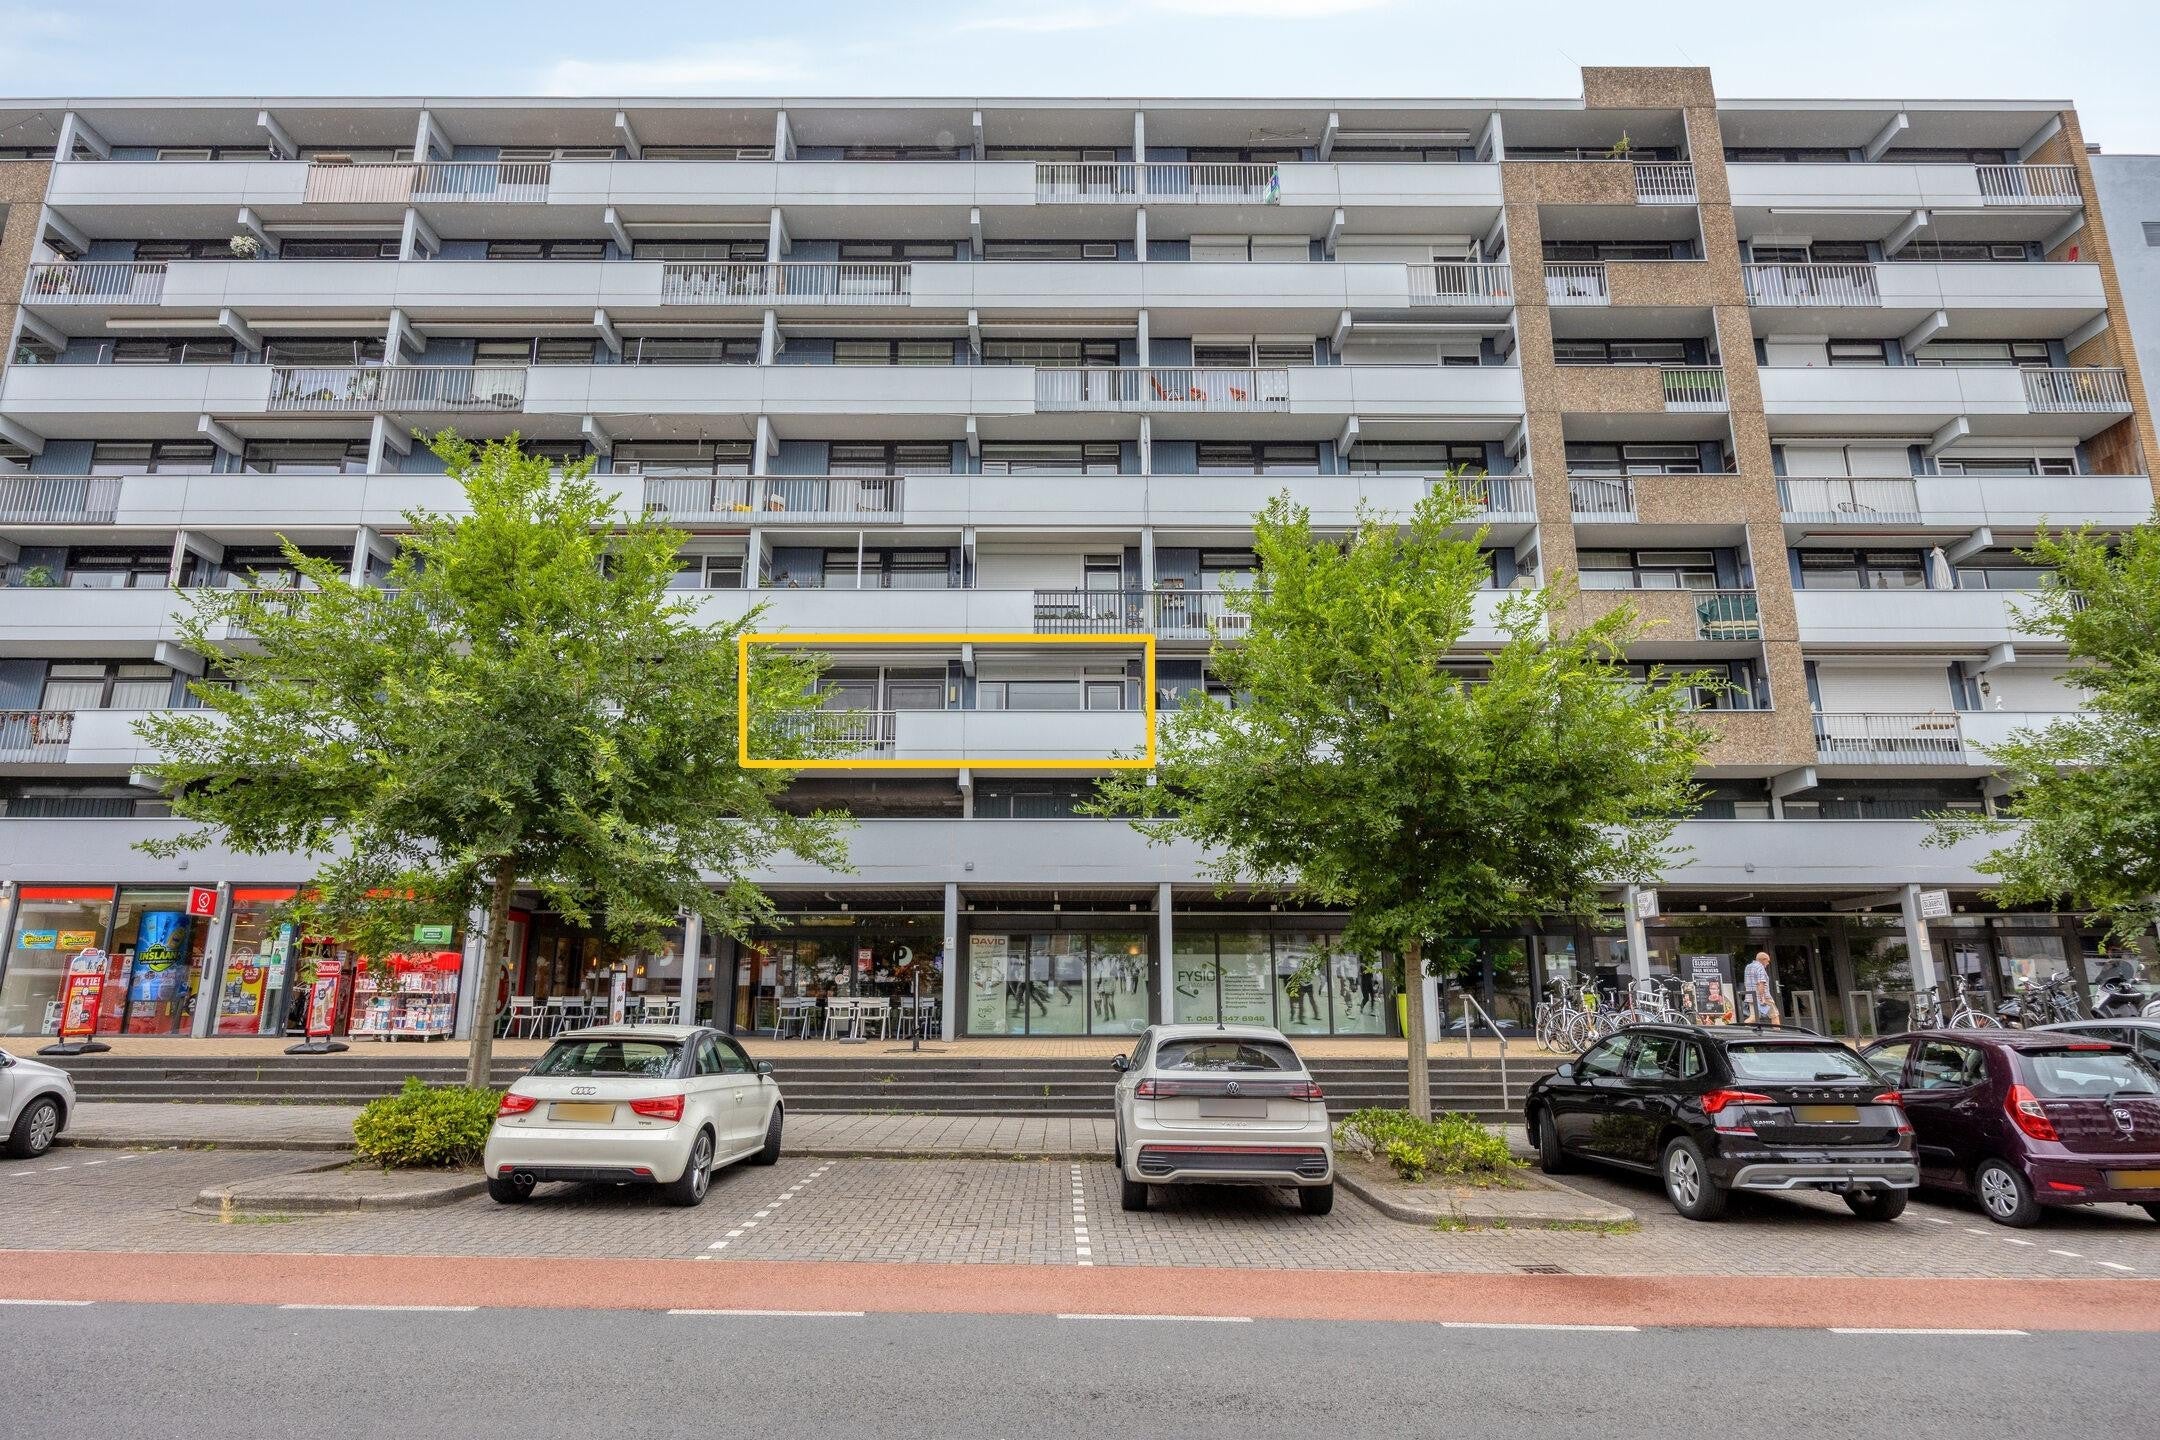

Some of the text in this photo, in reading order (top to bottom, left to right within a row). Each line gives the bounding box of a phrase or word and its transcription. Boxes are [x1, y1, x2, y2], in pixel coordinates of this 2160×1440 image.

[140, 951, 177, 961] INSLAAN
[75, 976, 101, 987] ACTIE!
[1178, 971, 1216, 982] FYSIO
